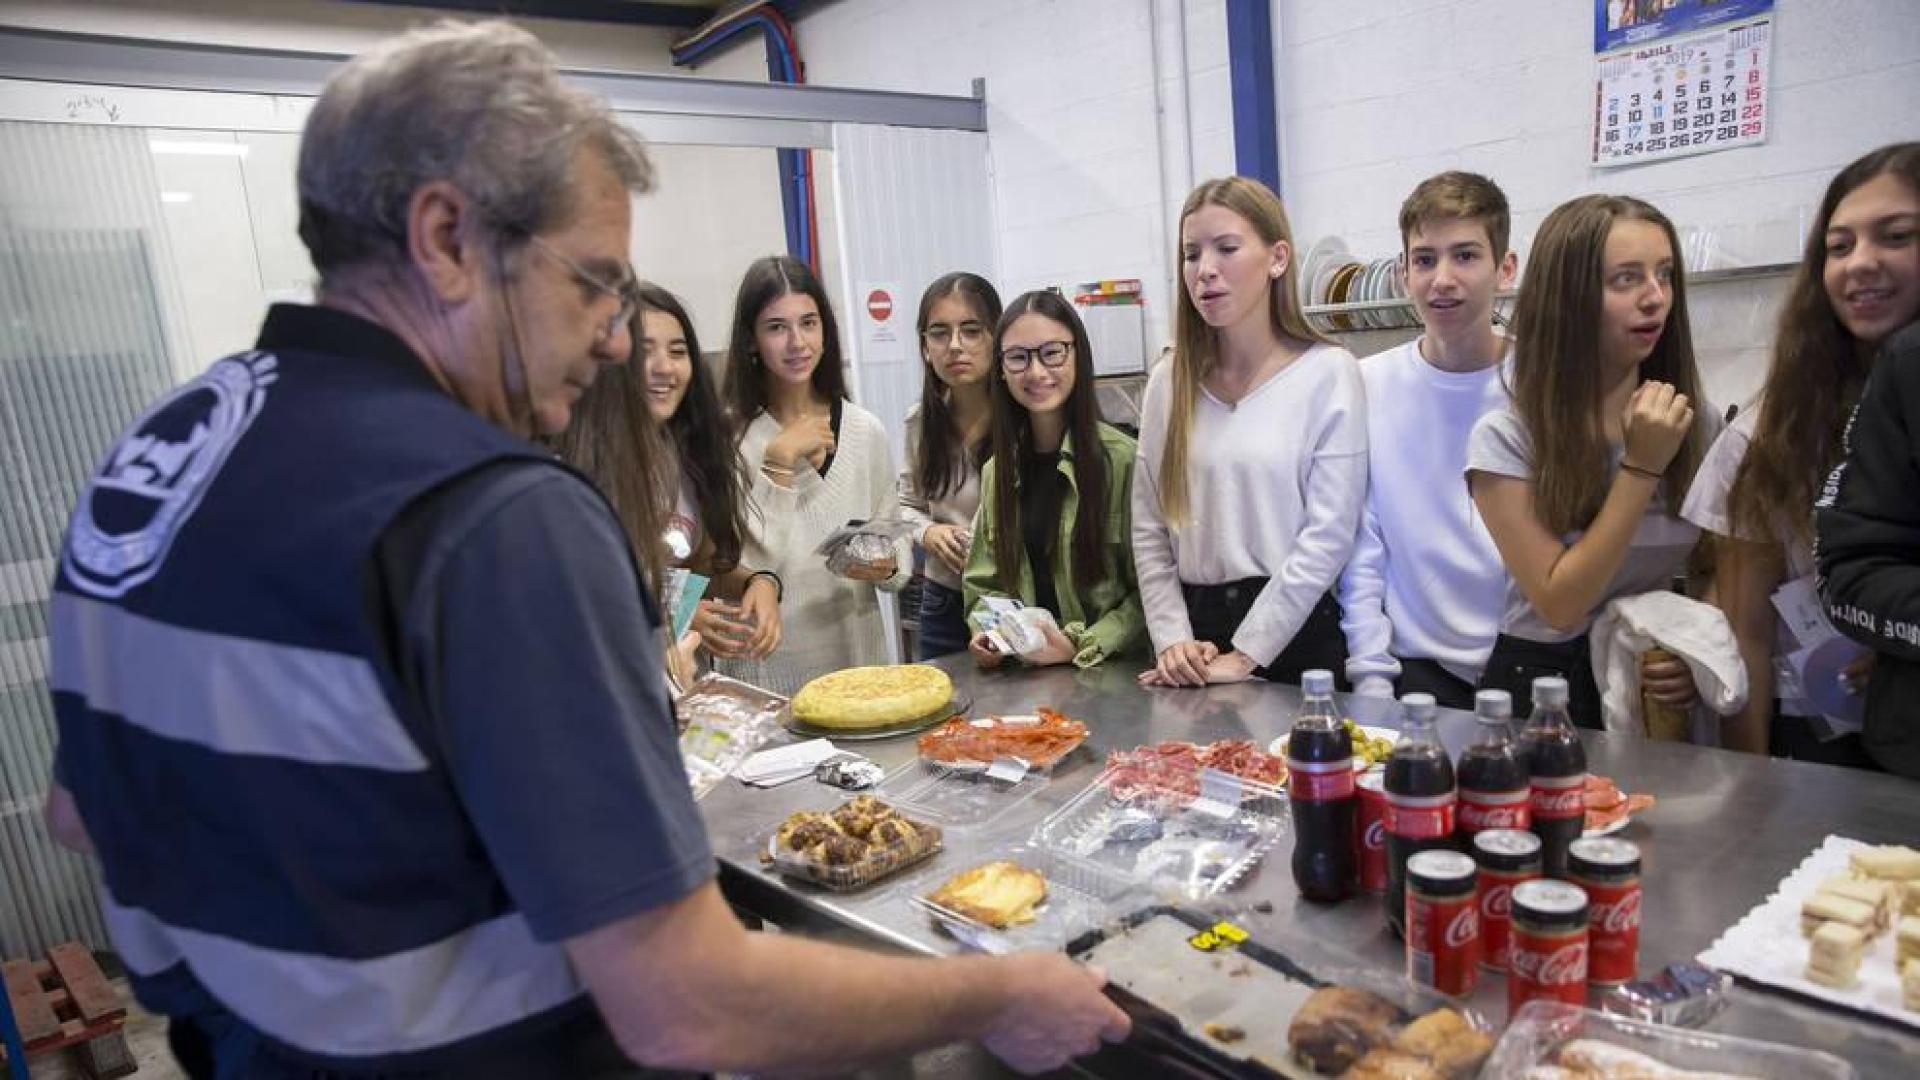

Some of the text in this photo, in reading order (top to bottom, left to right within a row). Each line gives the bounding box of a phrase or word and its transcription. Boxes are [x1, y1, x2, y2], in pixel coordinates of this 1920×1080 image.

[1752, 51, 1758, 66] 1
[1608, 69, 1760, 112] 2 3 4 5 6 7 8
[1608, 87, 1761, 127] 9 10 11 12 13 14 15
[1605, 104, 1762, 142] 16 17 18 19 20 21 22
[1624, 141, 1643, 156] 24
[1646, 137, 1667, 152] 25
[1670, 133, 1690, 148] 26
[1693, 129, 1714, 145] 27
[1717, 125, 1738, 140] 28
[1741, 121, 1762, 137] 29
